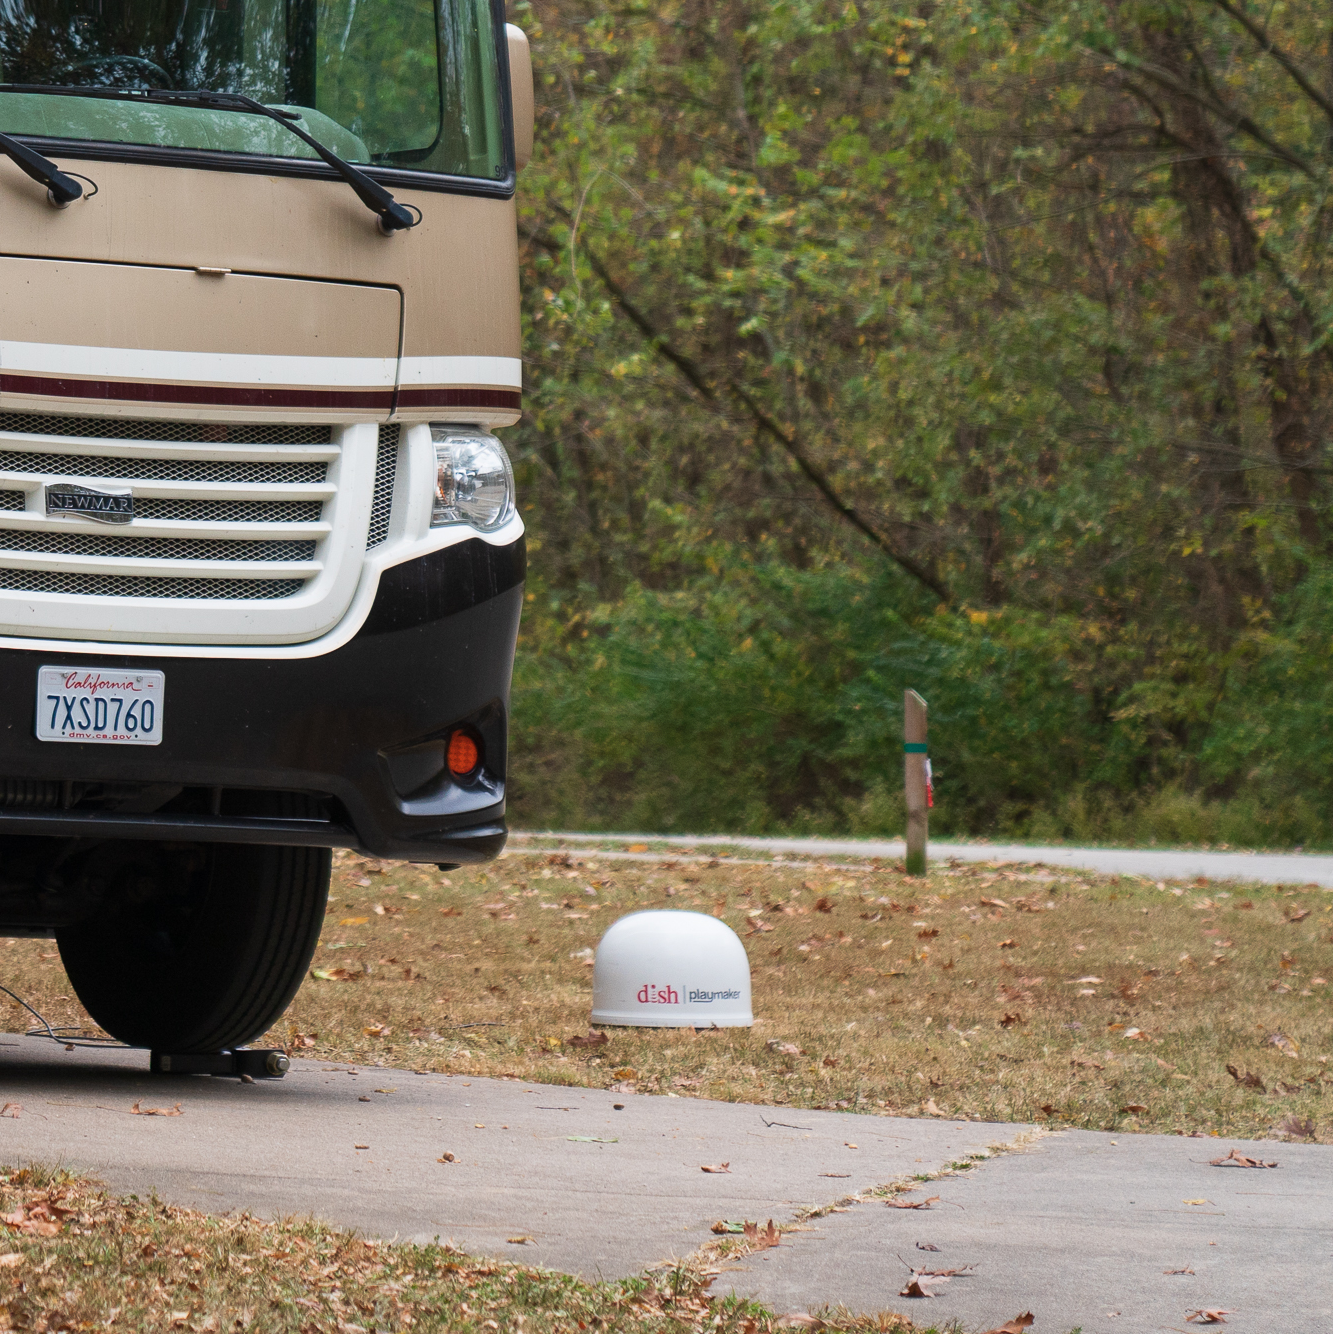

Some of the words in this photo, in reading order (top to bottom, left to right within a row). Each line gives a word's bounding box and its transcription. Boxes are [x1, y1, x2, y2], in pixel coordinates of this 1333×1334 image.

[49, 494, 132, 512] NEWMAR
[64, 671, 142, 695] California
[46, 694, 155, 733] 7XSD760
[68, 732, 132, 740] dmv.ca.gov
[637, 984, 680, 1004] dish
[689, 988, 741, 1003] playmaker
